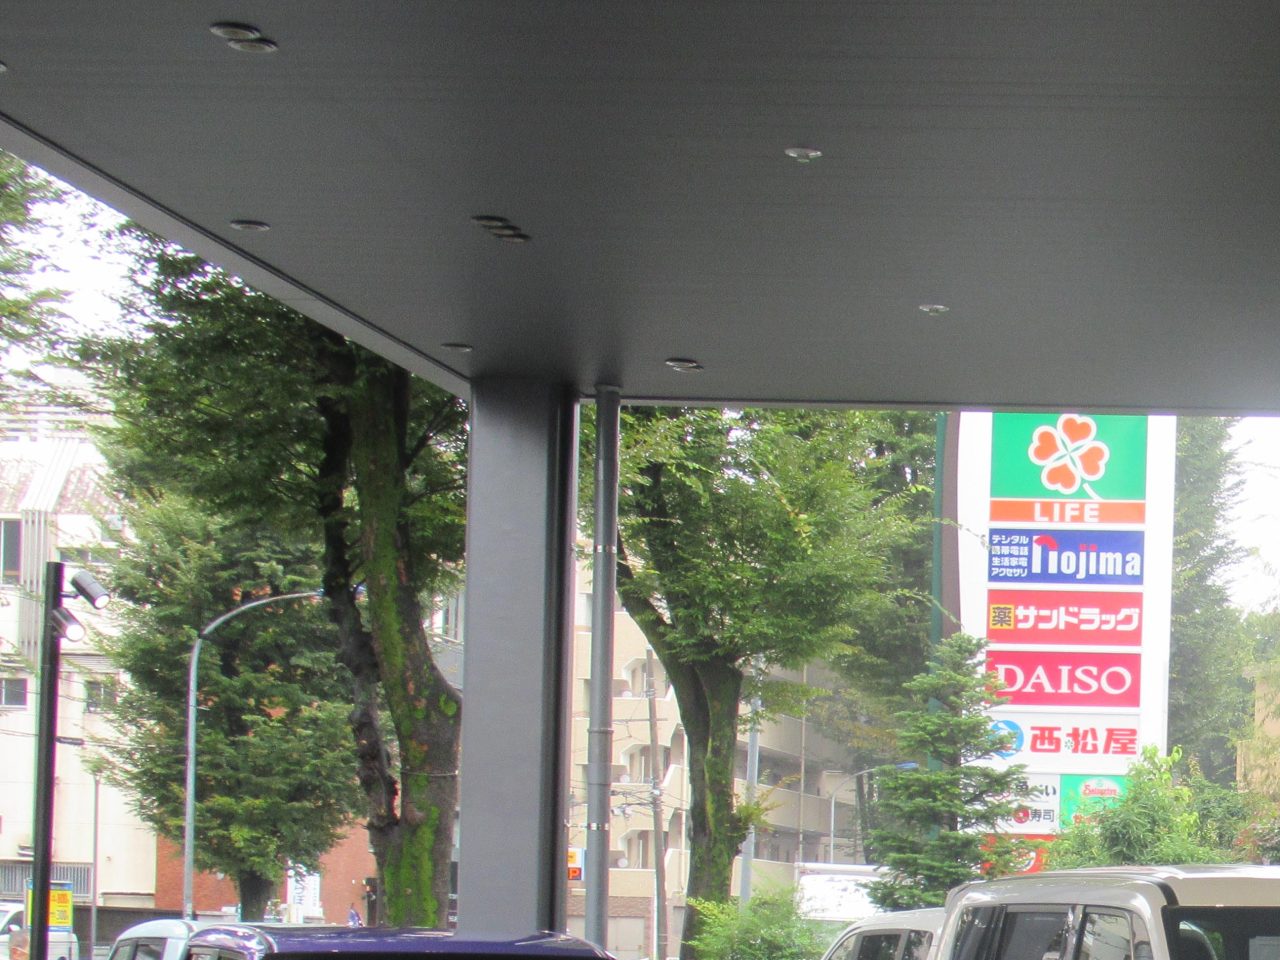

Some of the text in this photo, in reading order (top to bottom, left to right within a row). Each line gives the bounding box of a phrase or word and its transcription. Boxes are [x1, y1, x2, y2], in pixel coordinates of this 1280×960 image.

[1034, 503, 1099, 522] LIFE
[1032, 535, 1141, 579] nojima
[1015, 605, 1140, 631] サンドラッグ
[995, 665, 1132, 694] DAISO
[1030, 726, 1138, 755] 西松屋
